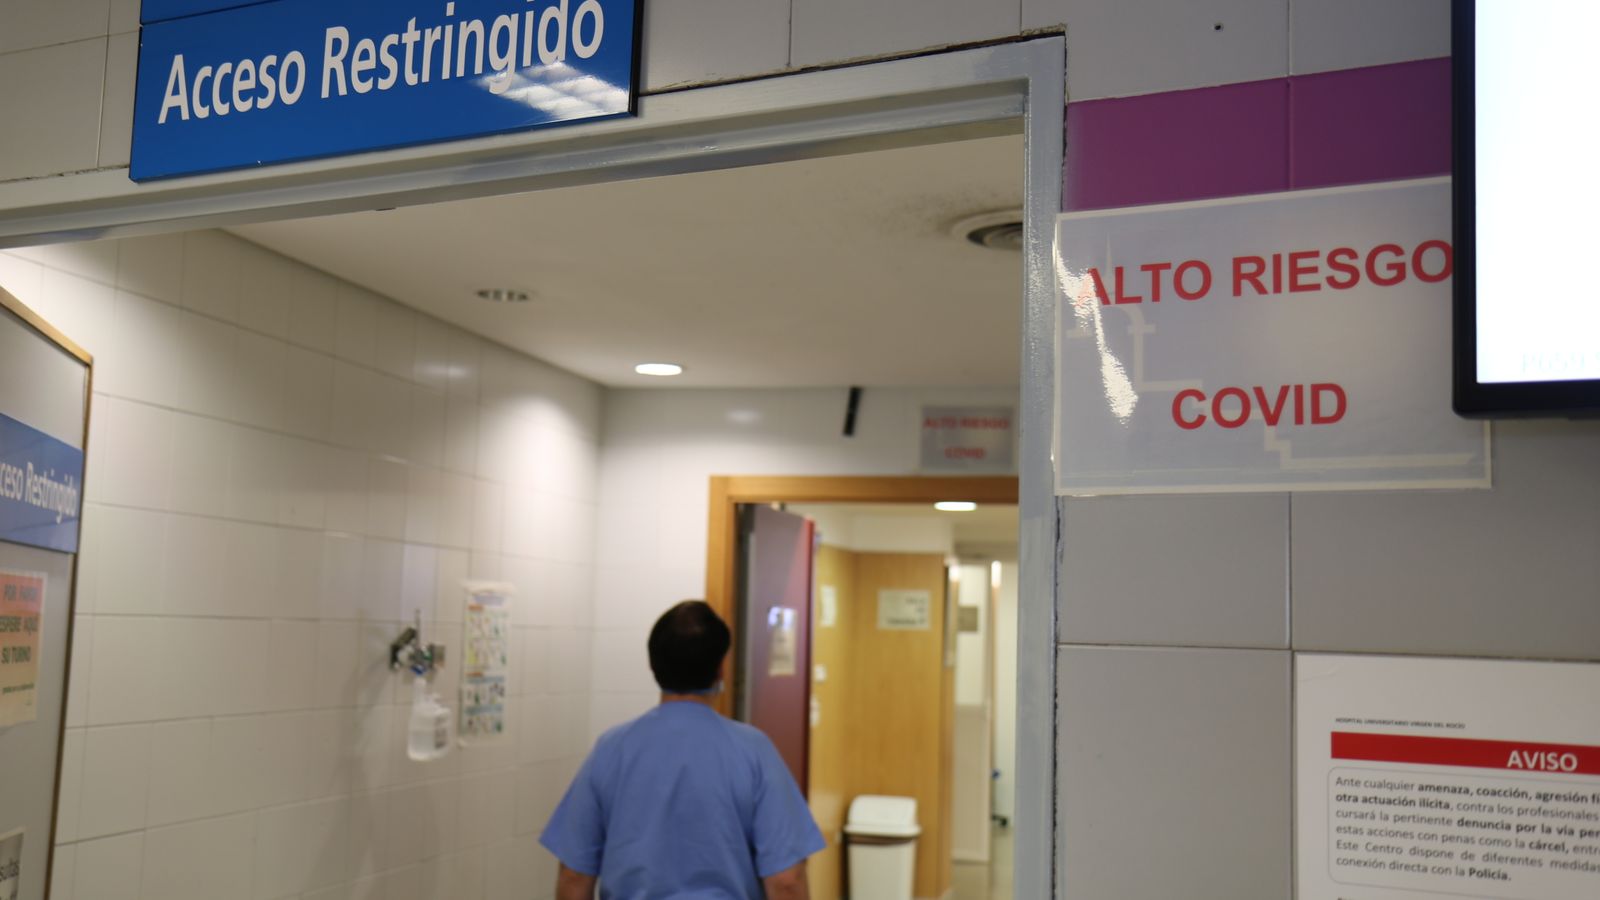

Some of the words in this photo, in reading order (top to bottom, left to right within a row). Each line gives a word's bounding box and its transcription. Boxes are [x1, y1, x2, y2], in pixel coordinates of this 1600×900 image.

[157, 50, 305, 125] Acceso
[320, 0, 605, 98] Restringido
[1076, 260, 1212, 306] ALTO
[1232, 239, 1453, 297] RIESGO
[1171, 383, 1347, 430] COVID
[24, 461, 78, 524] Restringido
[1506, 750, 1578, 772] AVISO
[1336, 776, 1361, 787] Ante
[1363, 779, 1415, 791] cualquier
[1418, 784, 1474, 796] amenaza,
[1476, 787, 1533, 801] coacción,
[1535, 791, 1588, 804] agresión
[1335, 793, 1359, 803] otra
[1361, 795, 1416, 807] actuación
[1418, 798, 1453, 811] ilícita,
[1456, 803, 1494, 814] contra
[1497, 804, 1514, 816] los
[1517, 806, 1600, 821] profesionales
[1336, 809, 1376, 821] cursará
[1380, 811, 1389, 821] la
[1393, 814, 1453, 826] pertinente
[1456, 817, 1512, 831] denuncia
[1516, 823, 1537, 834] por
[1541, 823, 1552, 835] la
[1556, 824, 1575, 836] vía
[1336, 825, 1363, 836] estas
[1366, 827, 1415, 839] acciones
[1417, 831, 1438, 841] con
[1441, 833, 1475, 844] penas
[1478, 836, 1512, 848] como
[1515, 837, 1526, 849] la
[1528, 839, 1569, 854] cárcel,
[1573, 844, 1600, 856] entr
[1336, 840, 1359, 851] Este
[1365, 842, 1403, 855] Centro
[1409, 847, 1454, 859] dispone
[1460, 850, 1475, 861] de
[1482, 851, 1543, 868] diferentes
[1336, 857, 1385, 870] conexión
[1389, 860, 1428, 873] directa
[1431, 865, 1452, 876] con
[1455, 866, 1465, 877] la
[1468, 867, 1512, 881] Policía.
